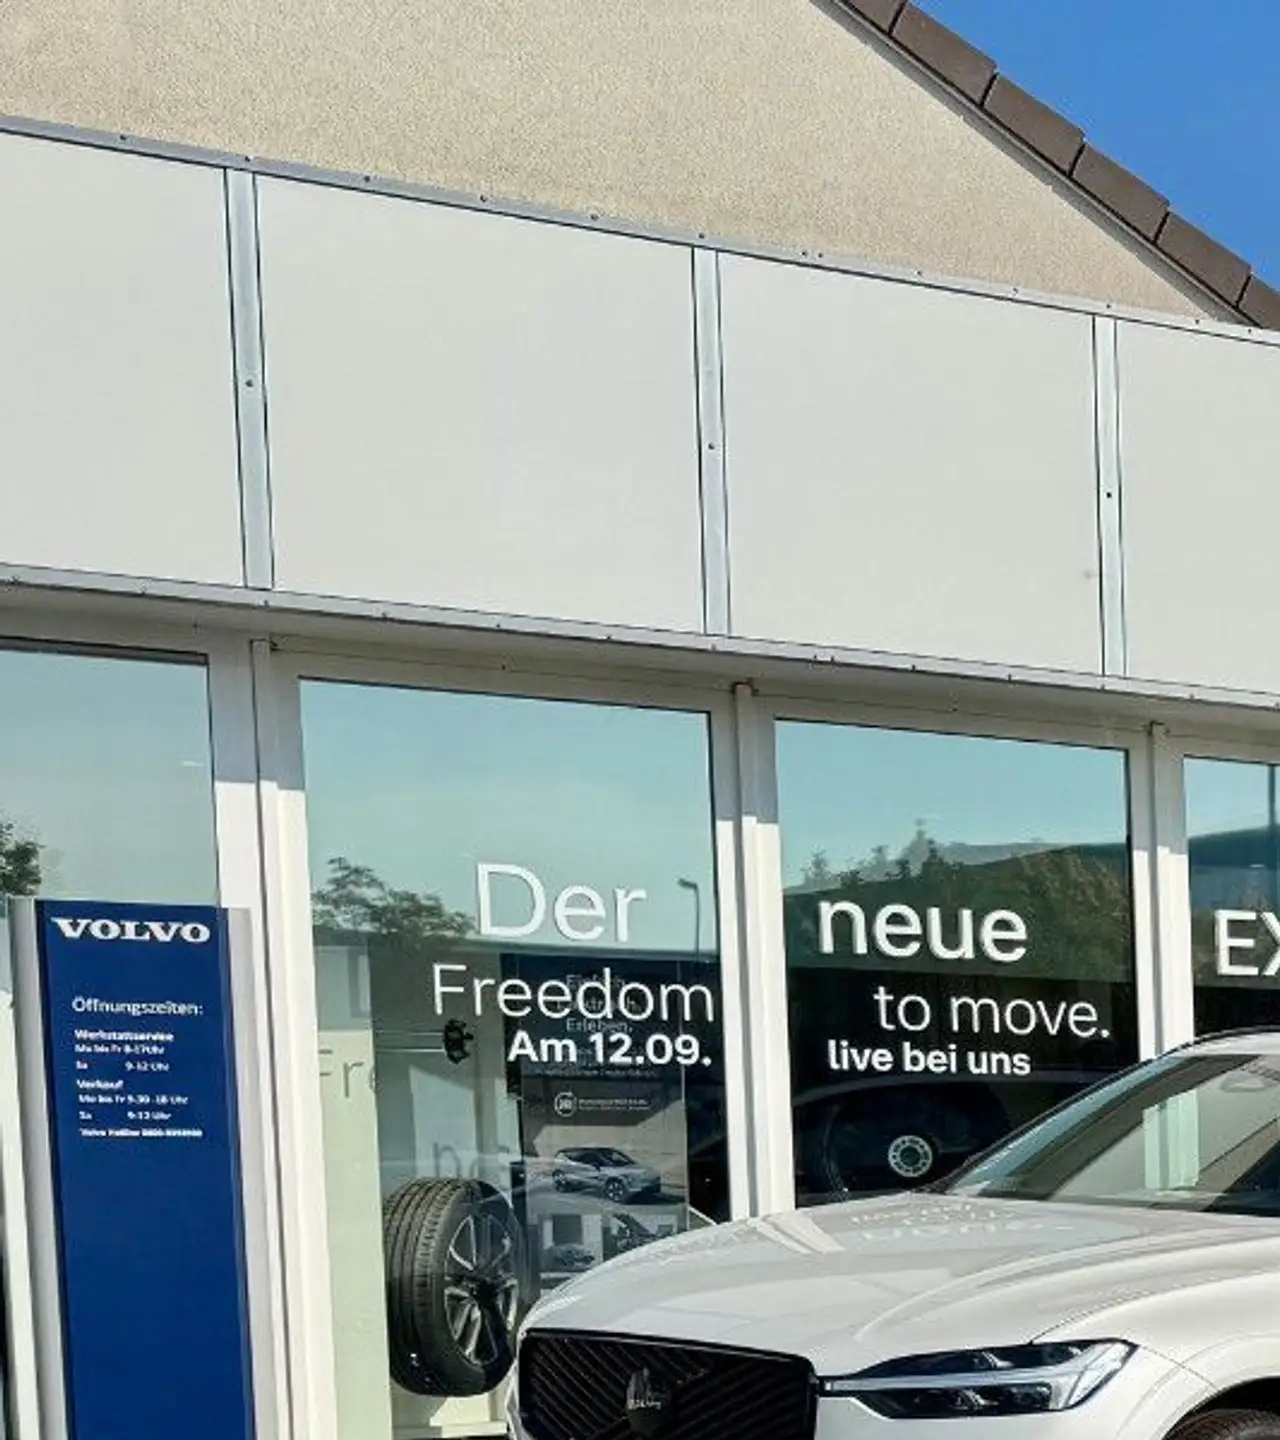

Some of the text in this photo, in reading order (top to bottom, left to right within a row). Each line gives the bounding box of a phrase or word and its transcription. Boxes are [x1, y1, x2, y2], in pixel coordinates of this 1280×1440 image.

[477, 863, 647, 942] Der
[50, 917, 211, 943] VOLVO
[818, 900, 1027, 962] neue
[71, 995, 204, 1017] Öffnungszeiten:
[433, 962, 714, 1022] Freedom
[872, 985, 1111, 1038] to move.
[507, 1029, 578, 1063] Am
[589, 1031, 712, 1067] 12.09.
[827, 1038, 1032, 1076] live bei uns
